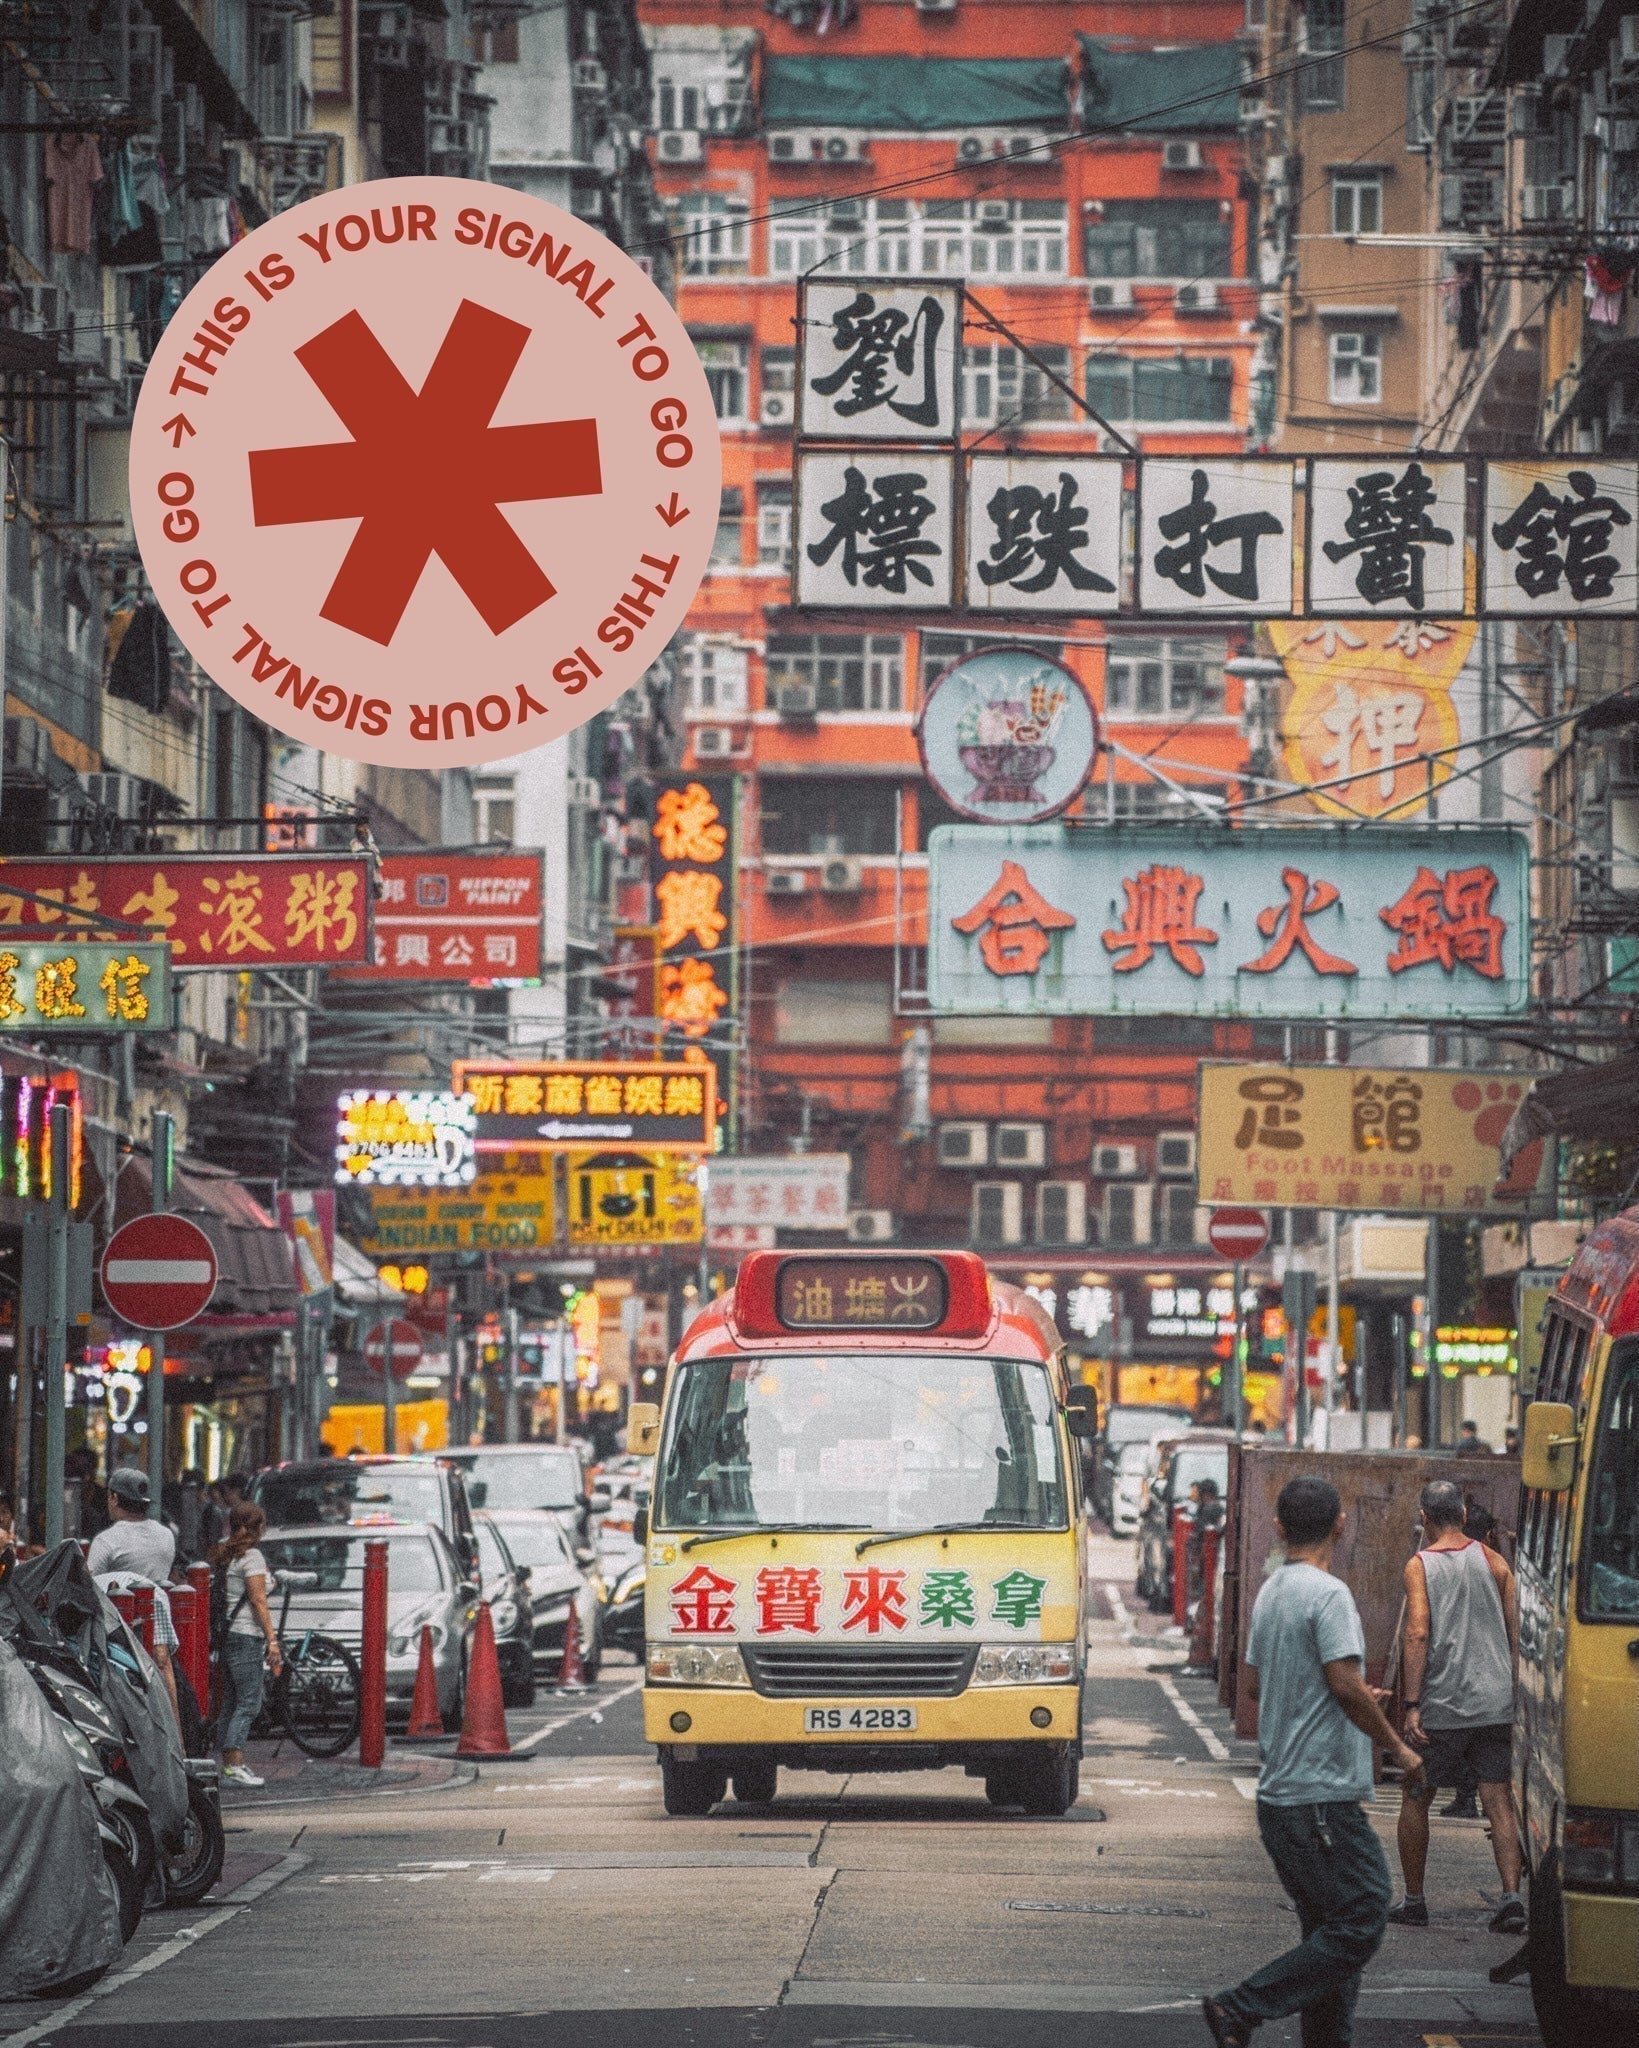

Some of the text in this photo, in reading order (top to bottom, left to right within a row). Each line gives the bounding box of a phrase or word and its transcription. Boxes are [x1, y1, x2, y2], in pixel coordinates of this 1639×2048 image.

[811, 292, 942, 428] 劉
[1321, 682, 1426, 800] 押
[459, 877, 530, 892] NIPPON
[466, 890, 522, 905] PAINT
[950, 859, 1507, 979] 合興火鍋
[1247, 1151, 1453, 1182] Foot Massage
[377, 1220, 538, 1247] INDIAN FOOD
[810, 1707, 912, 1729] RS 4283
